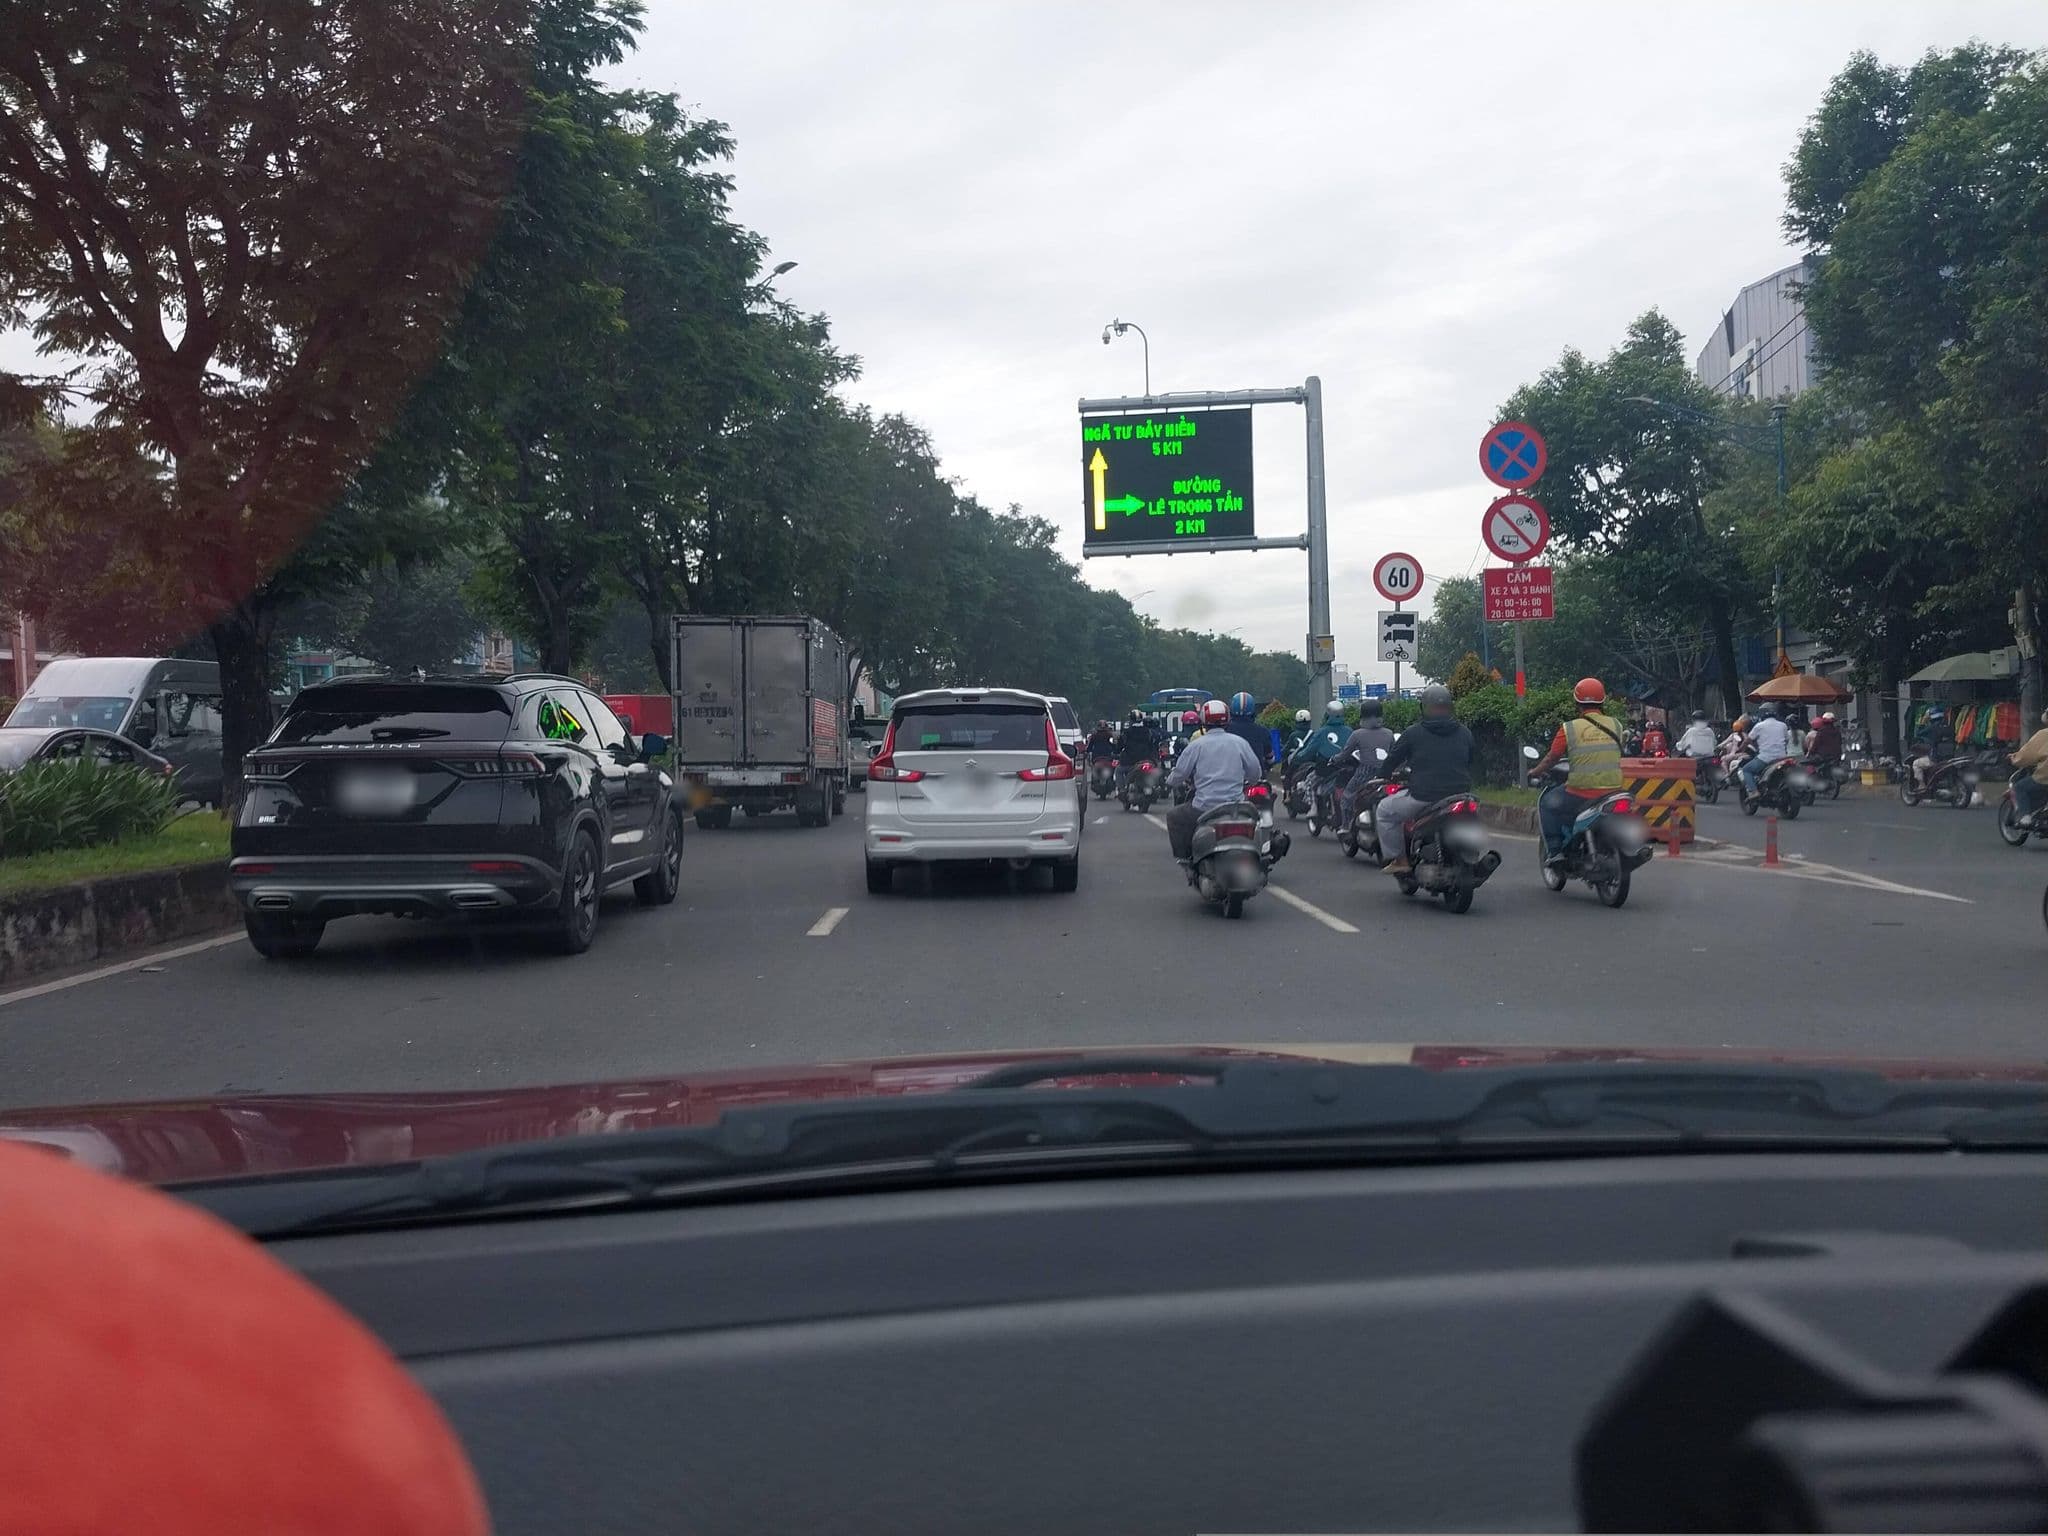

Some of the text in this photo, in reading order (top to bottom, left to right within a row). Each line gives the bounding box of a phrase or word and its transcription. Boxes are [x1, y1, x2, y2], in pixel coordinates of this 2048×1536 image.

[1084, 423, 1111, 441] NGÃ
[1113, 425, 1133, 440] TƯ
[1152, 441, 1182, 456] 5 KM
[1148, 498, 1165, 515] LÊ
[1168, 499, 1212, 516] TRỌNG
[1175, 519, 1205, 534] 2 KM
[1388, 567, 1409, 588] 60
[1507, 569, 1531, 584] CẤM
[1490, 584, 1550, 595] XE 2 VÀ 3 BÁNH
